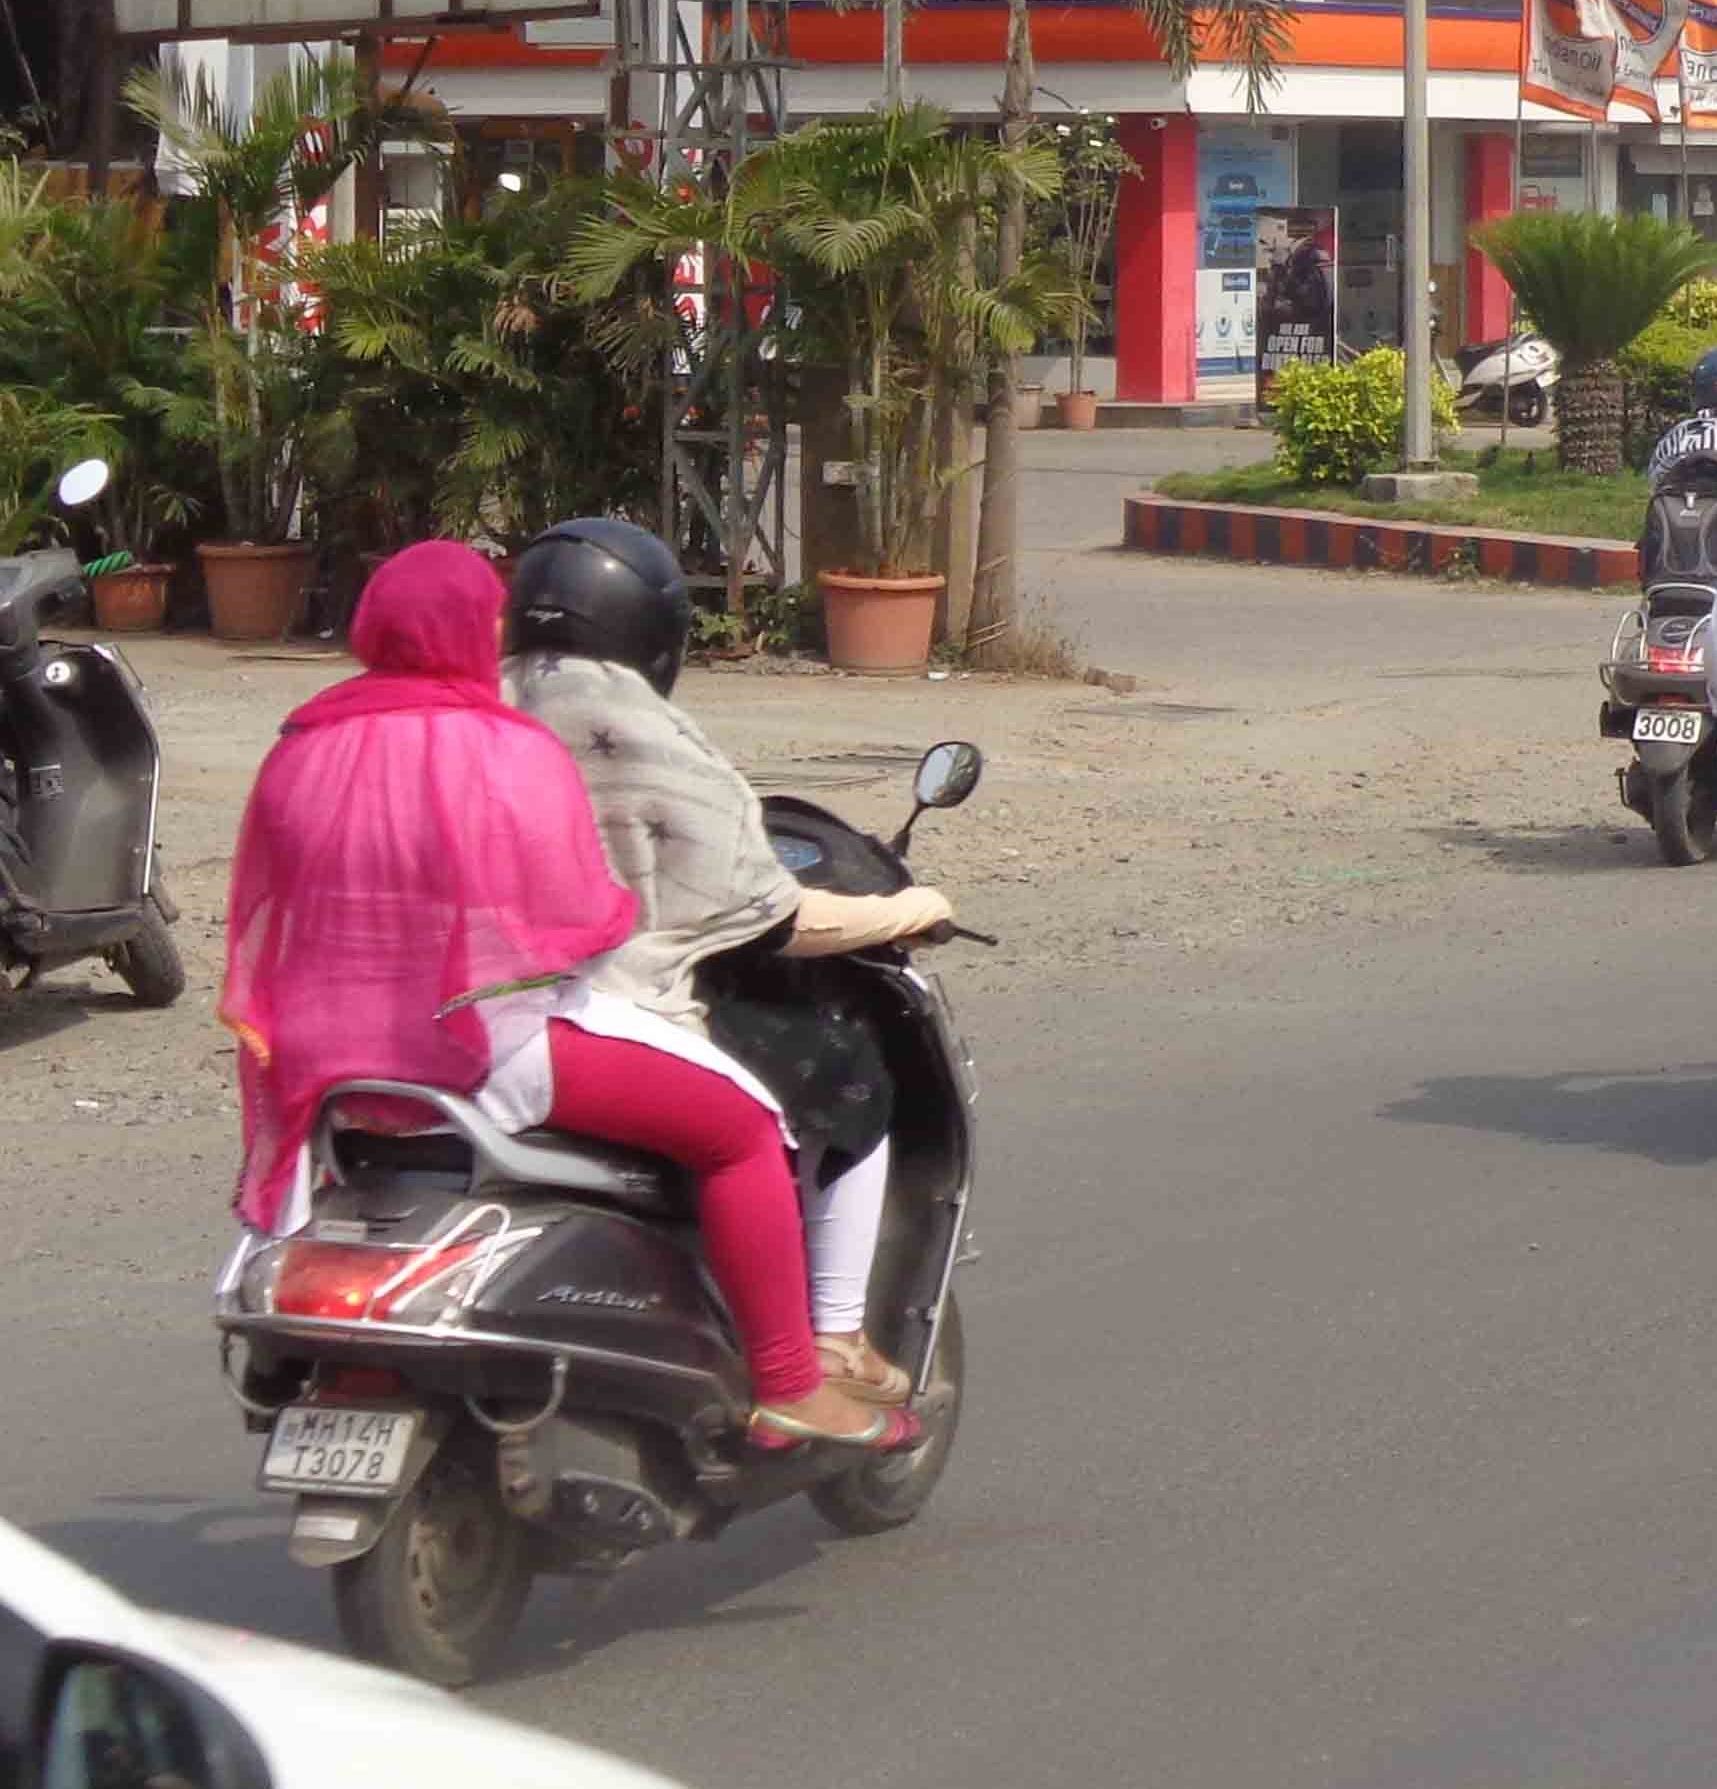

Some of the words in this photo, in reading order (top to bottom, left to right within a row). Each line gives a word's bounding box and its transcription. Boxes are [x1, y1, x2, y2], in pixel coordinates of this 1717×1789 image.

[1266, 336, 1297, 353] OPEN
[1299, 336, 1325, 353] FOR
[1638, 715, 1696, 740] 3008
[298, 1411, 396, 1446] MH14H
[292, 1445, 386, 1480] T3078
